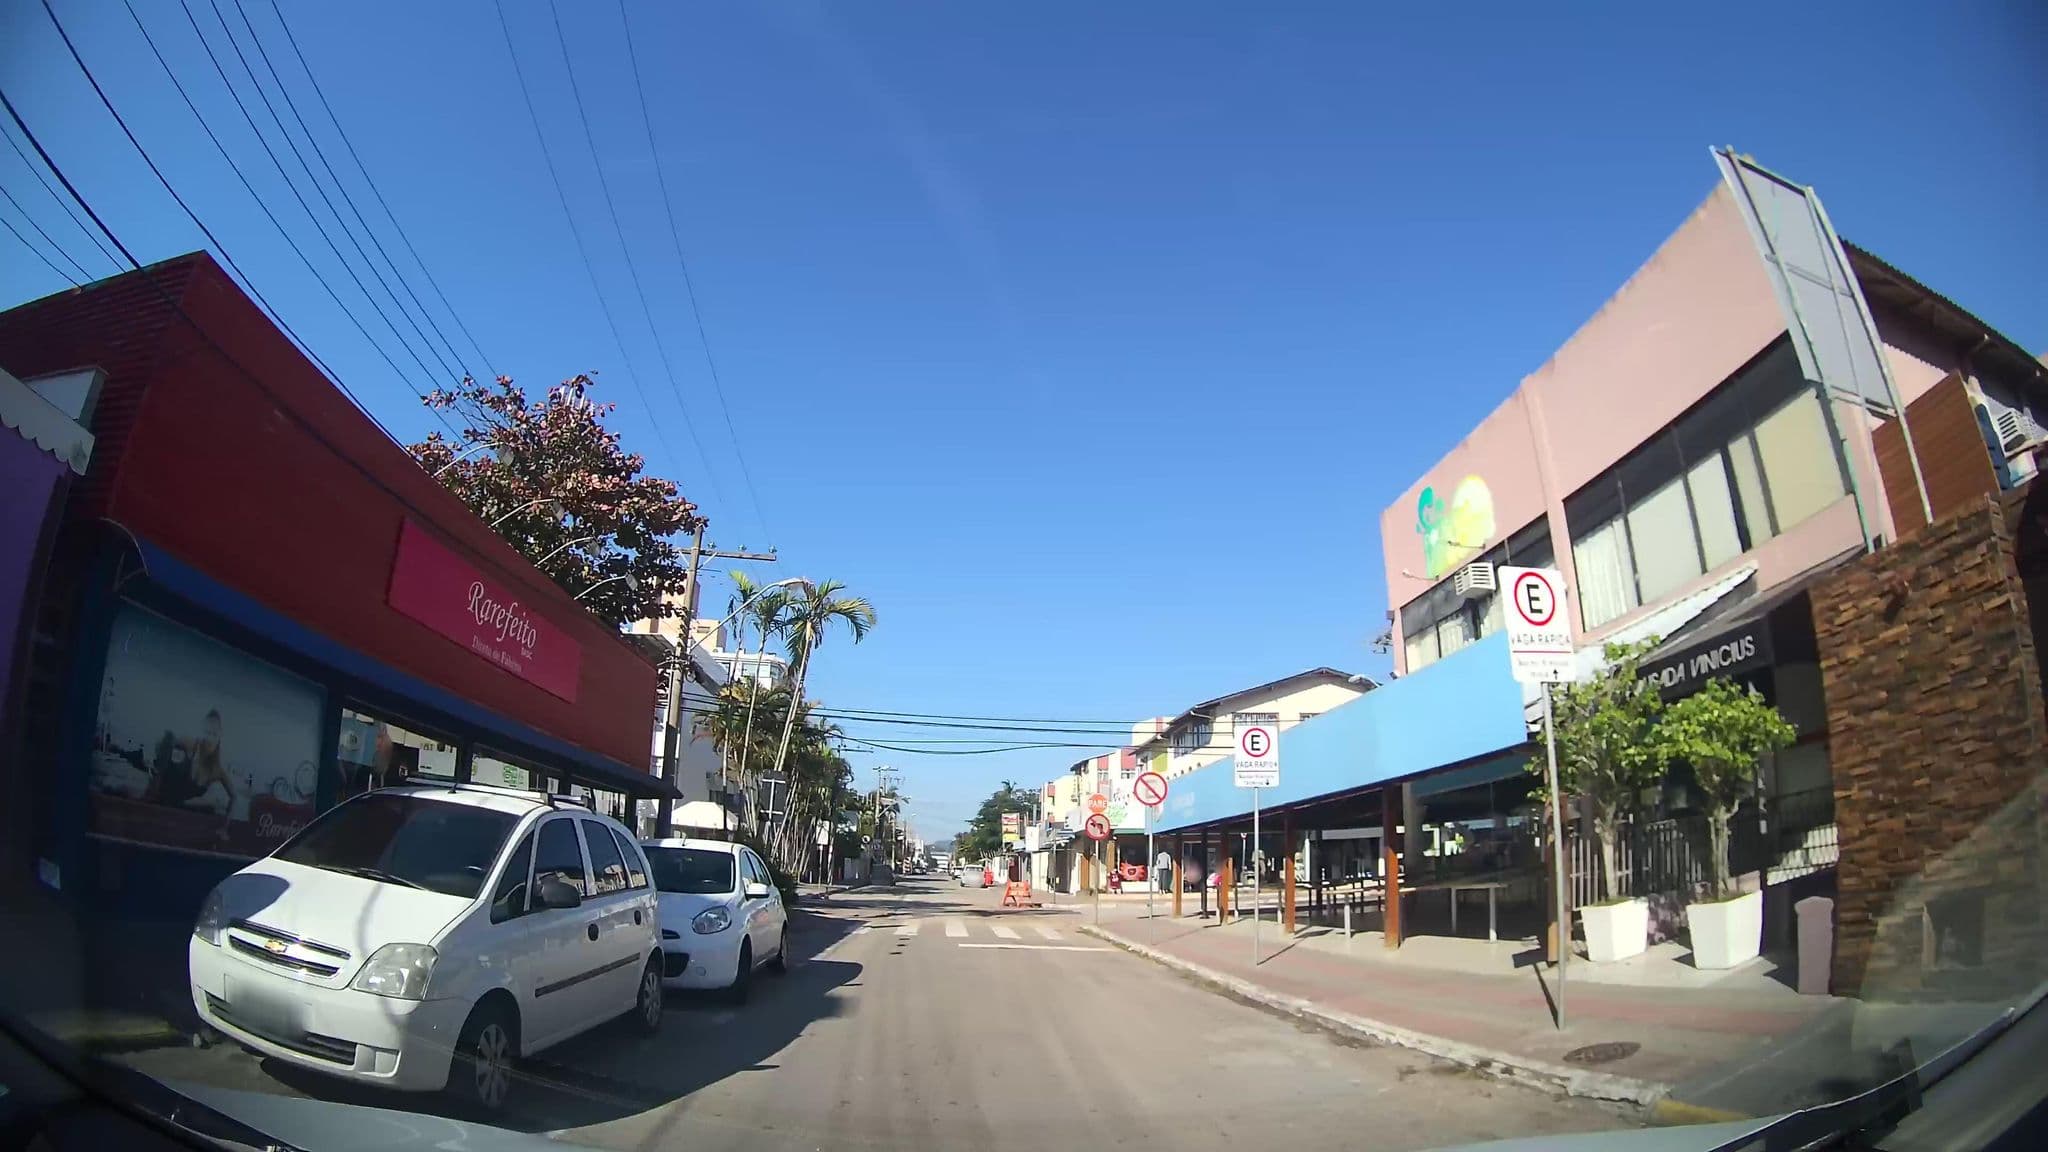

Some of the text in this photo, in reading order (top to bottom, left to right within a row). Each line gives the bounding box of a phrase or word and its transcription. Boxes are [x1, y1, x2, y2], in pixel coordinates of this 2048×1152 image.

[1526, 584, 1543, 614] E
[467, 581, 537, 649] Rarefeito
[1690, 635, 1755, 678] VINICIUS
[1251, 735, 1261, 751] E
[1088, 800, 1107, 808] PARE
